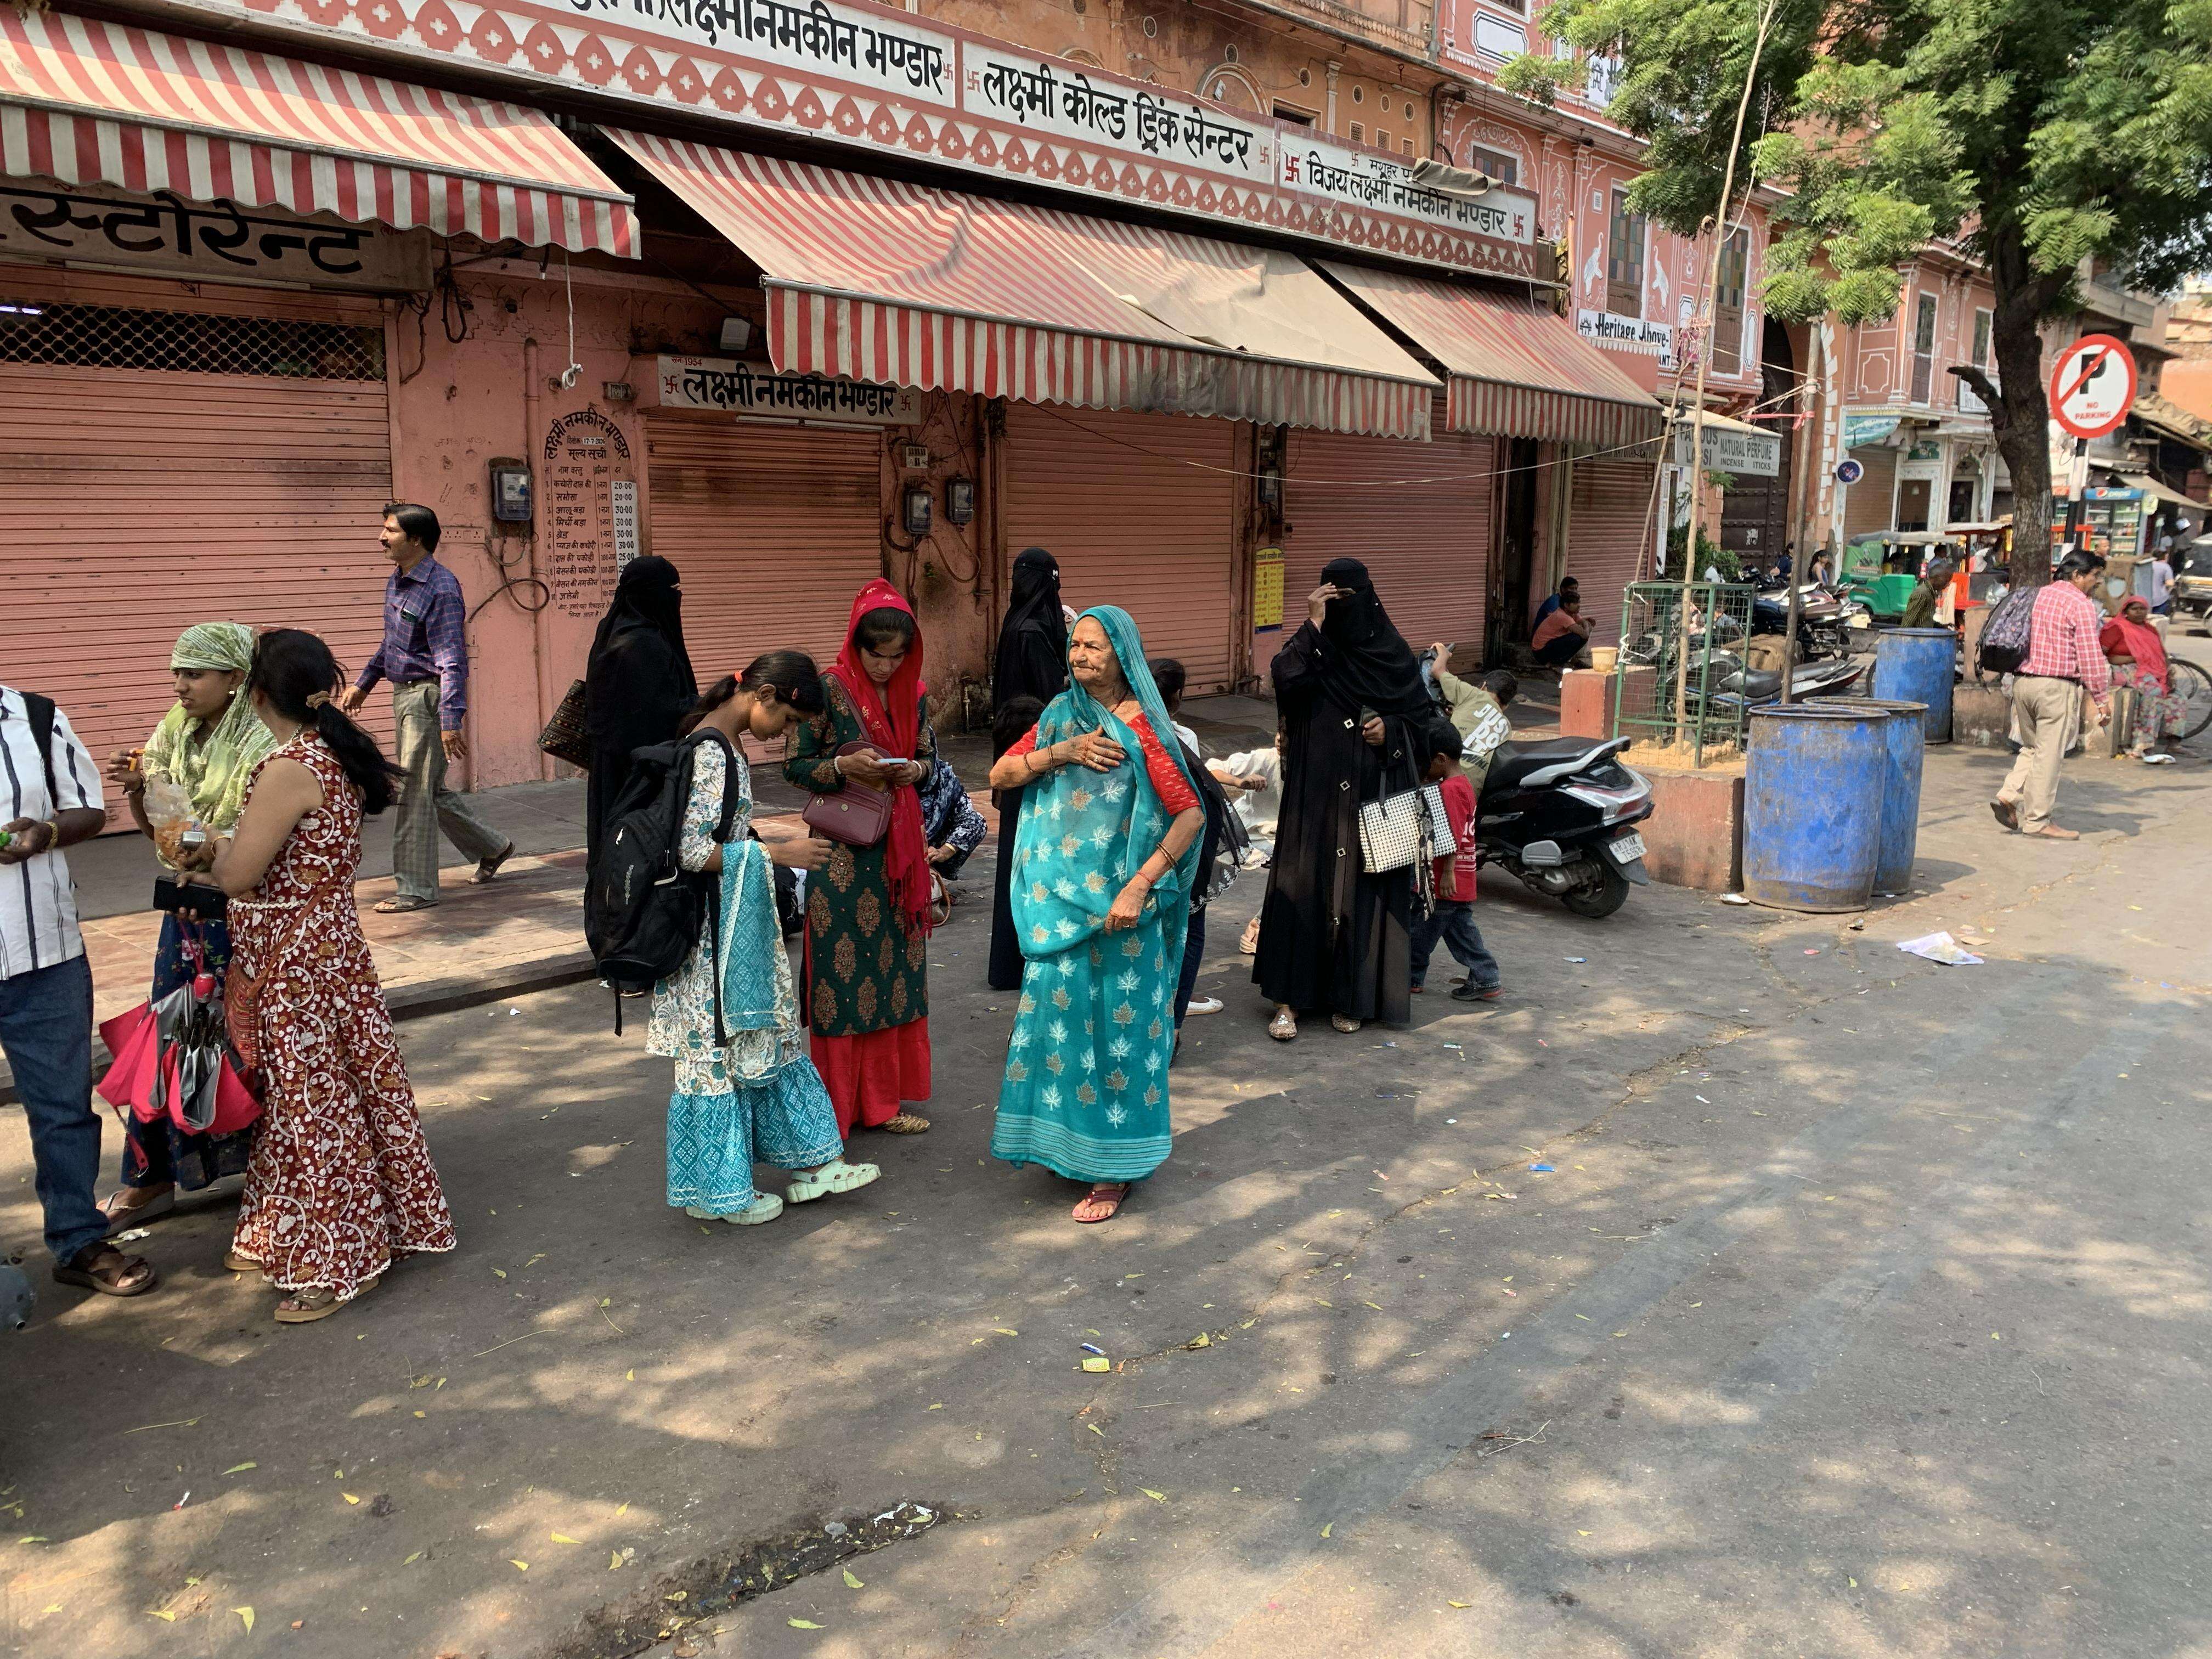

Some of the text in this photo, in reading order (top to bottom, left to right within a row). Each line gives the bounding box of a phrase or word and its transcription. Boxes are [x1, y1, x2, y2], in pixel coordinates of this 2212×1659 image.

[862, 28, 943, 95] भण्डार
[984, 62, 1058, 123] लक्ष्मी
[1063, 73, 1127, 140] कोल्ड
[1183, 106, 1253, 170] सेन्टर
[1307, 151, 1348, 195] विजय
[1350, 172, 1391, 206] लक्ष्मी
[1455, 199, 1506, 236] भण्डार
[1595, 313, 1635, 340] Heritage
[685, 357, 702, 366] 1954
[683, 362, 755, 410] लक्ष्मी
[839, 381, 897, 417] भण्डार
[2074, 410, 2112, 420] PARKING
[2086, 401, 2099, 409] NO
[544, 407, 630, 461] लक्ष्मी नमकीन भण्डार
[1680, 426, 1718, 445] FAOUS
[567, 447, 607, 461] मूल्य सूची
[1685, 445, 1712, 466] LASI
[1720, 439, 1745, 457] NATURAL
[1747, 441, 1772, 460] PERFUME
[1720, 458, 1745, 467] INCENSE
